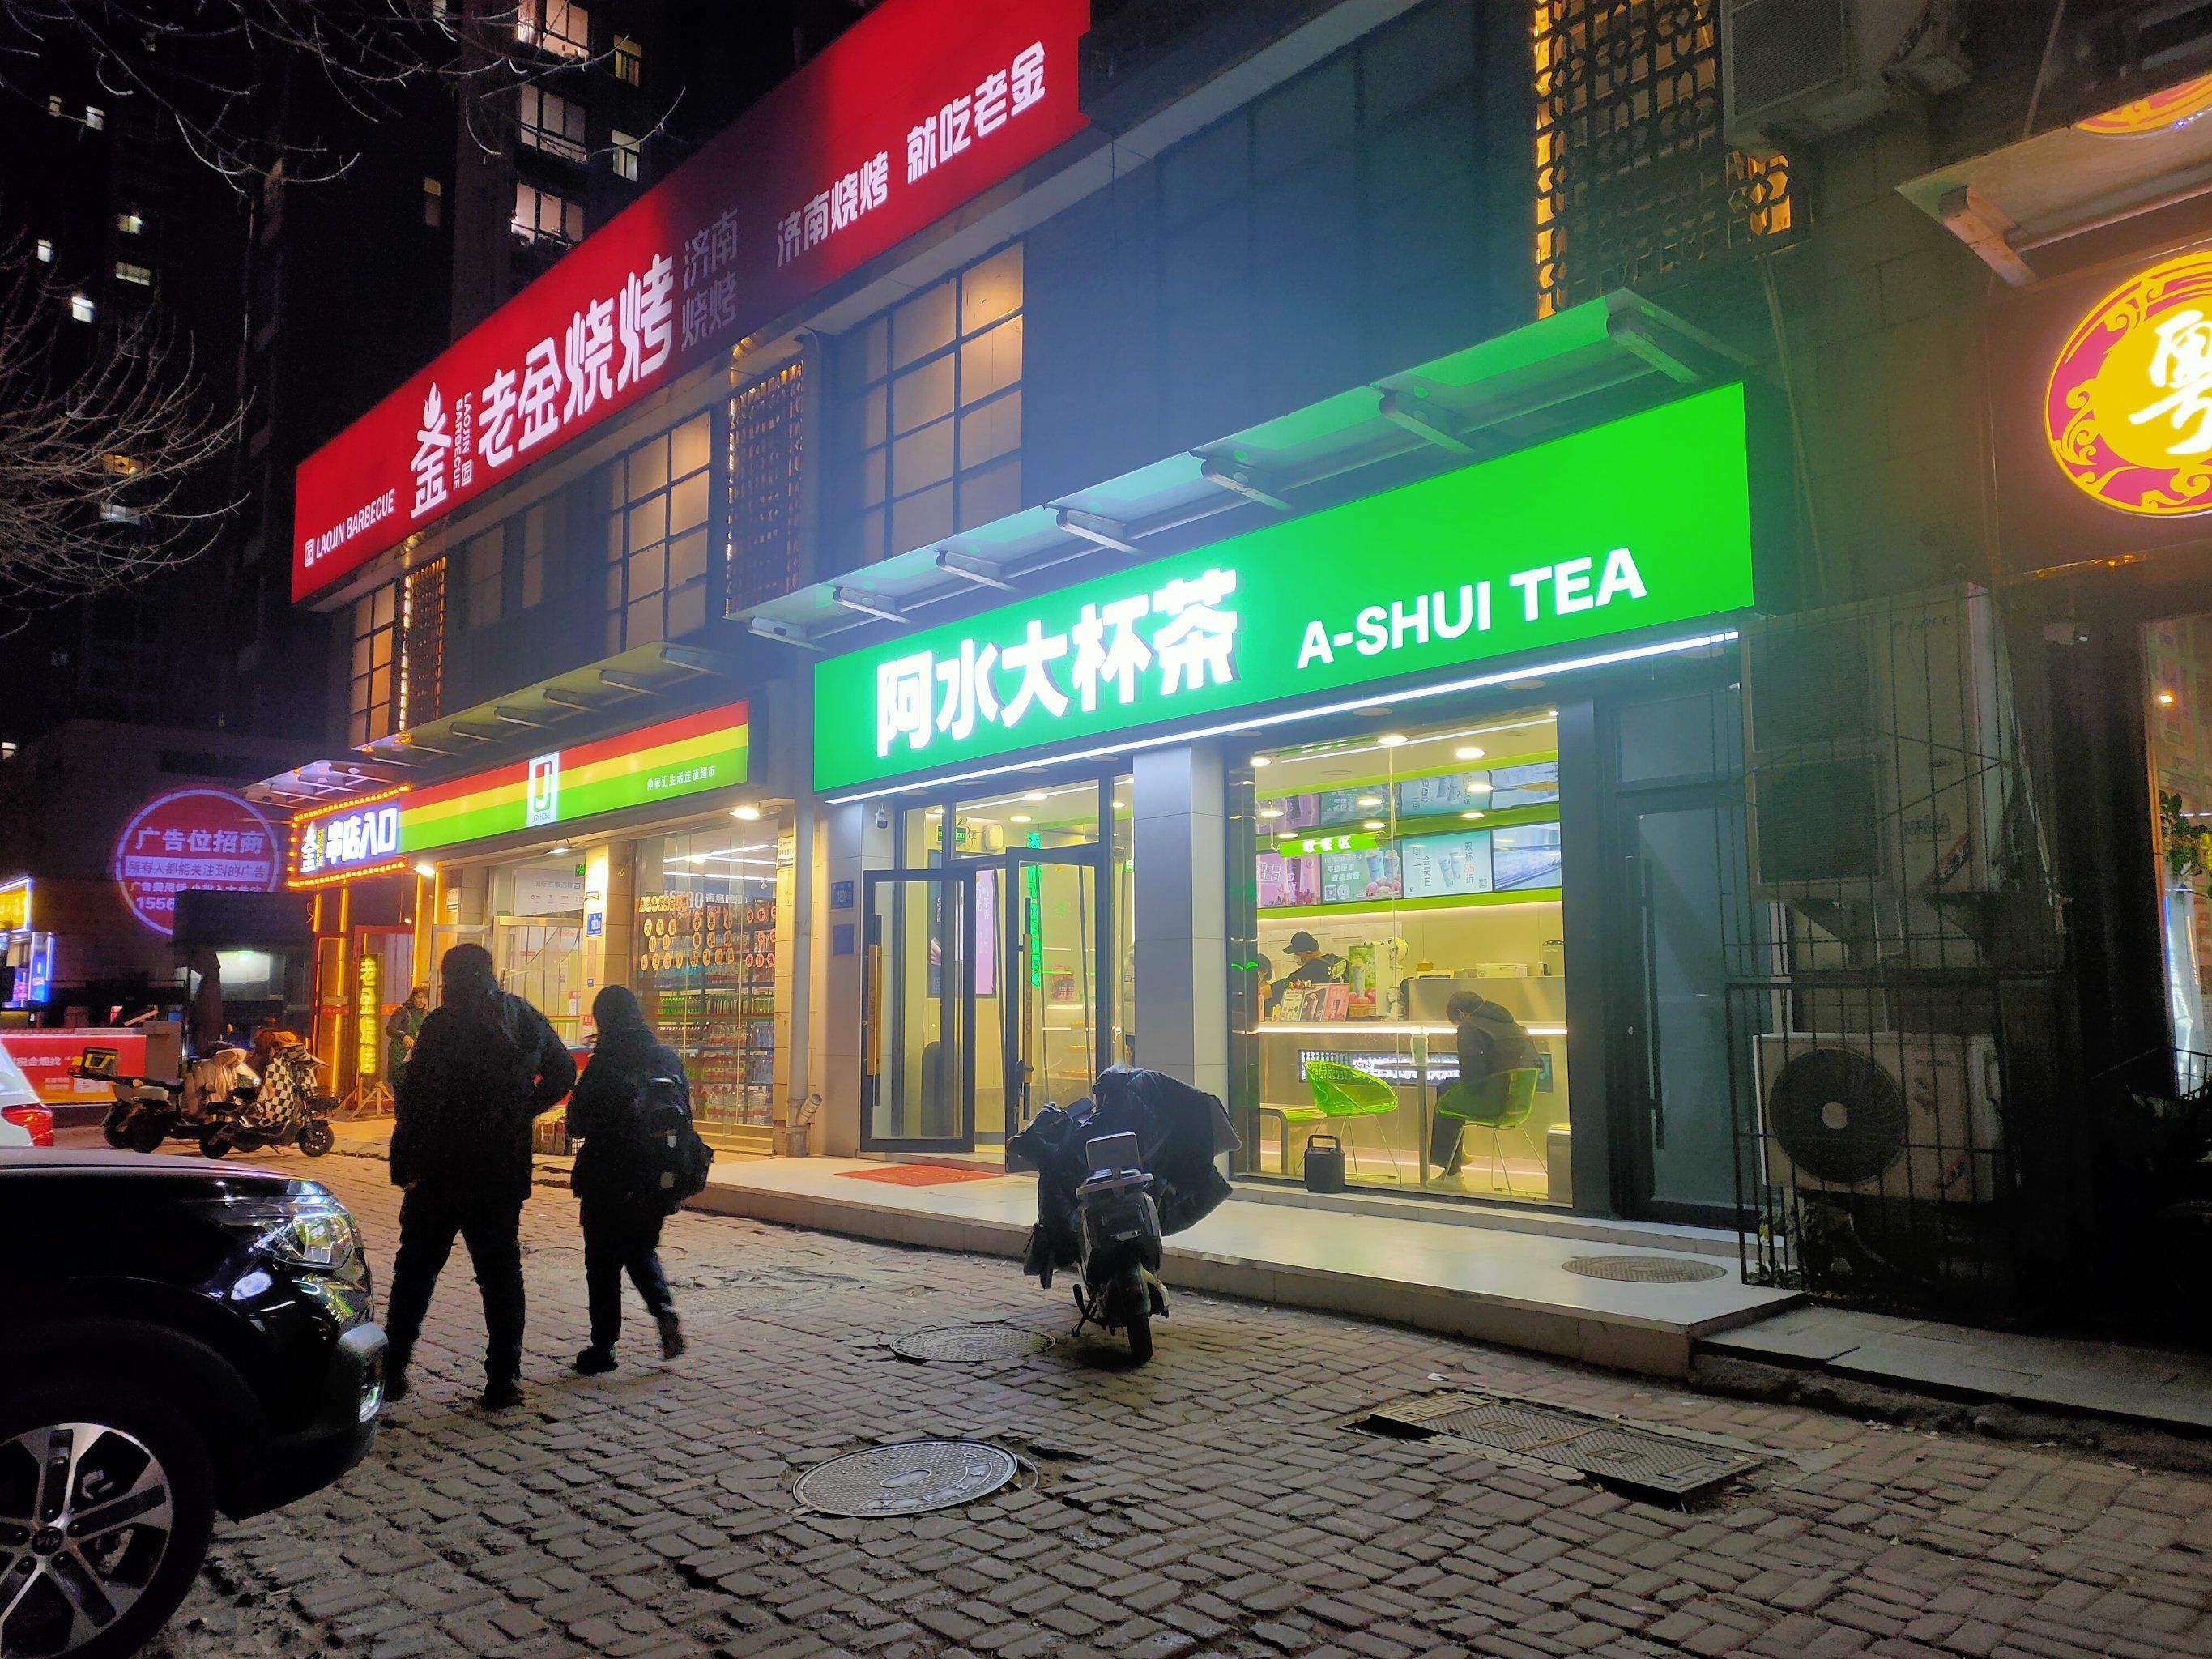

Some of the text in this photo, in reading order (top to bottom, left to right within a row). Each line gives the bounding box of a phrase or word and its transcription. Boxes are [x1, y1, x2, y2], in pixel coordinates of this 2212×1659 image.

[778, 41, 1046, 268] 济南烧烤 就吃老金
[683, 208, 738, 292] 济南
[681, 272, 737, 351] 烧烤
[478, 254, 674, 467] 老金烧烤
[453, 398, 463, 491] BARBECUE
[462, 391, 472, 454] LAOJIN
[316, 521, 345, 557] LAOJIN
[346, 488, 395, 539] BARBECUE
[1297, 547, 1647, 669] A-SHUI TEA
[876, 568, 1240, 757] 阿水大杯茶
[128, 860, 266, 879] 所有人都能关注到的广告
[135, 826, 266, 855] 广告位招商
[326, 807, 398, 864] 串店入口
[1422, 855, 1432, 888] 会员日
[1464, 842, 1475, 884] 双杯85折
